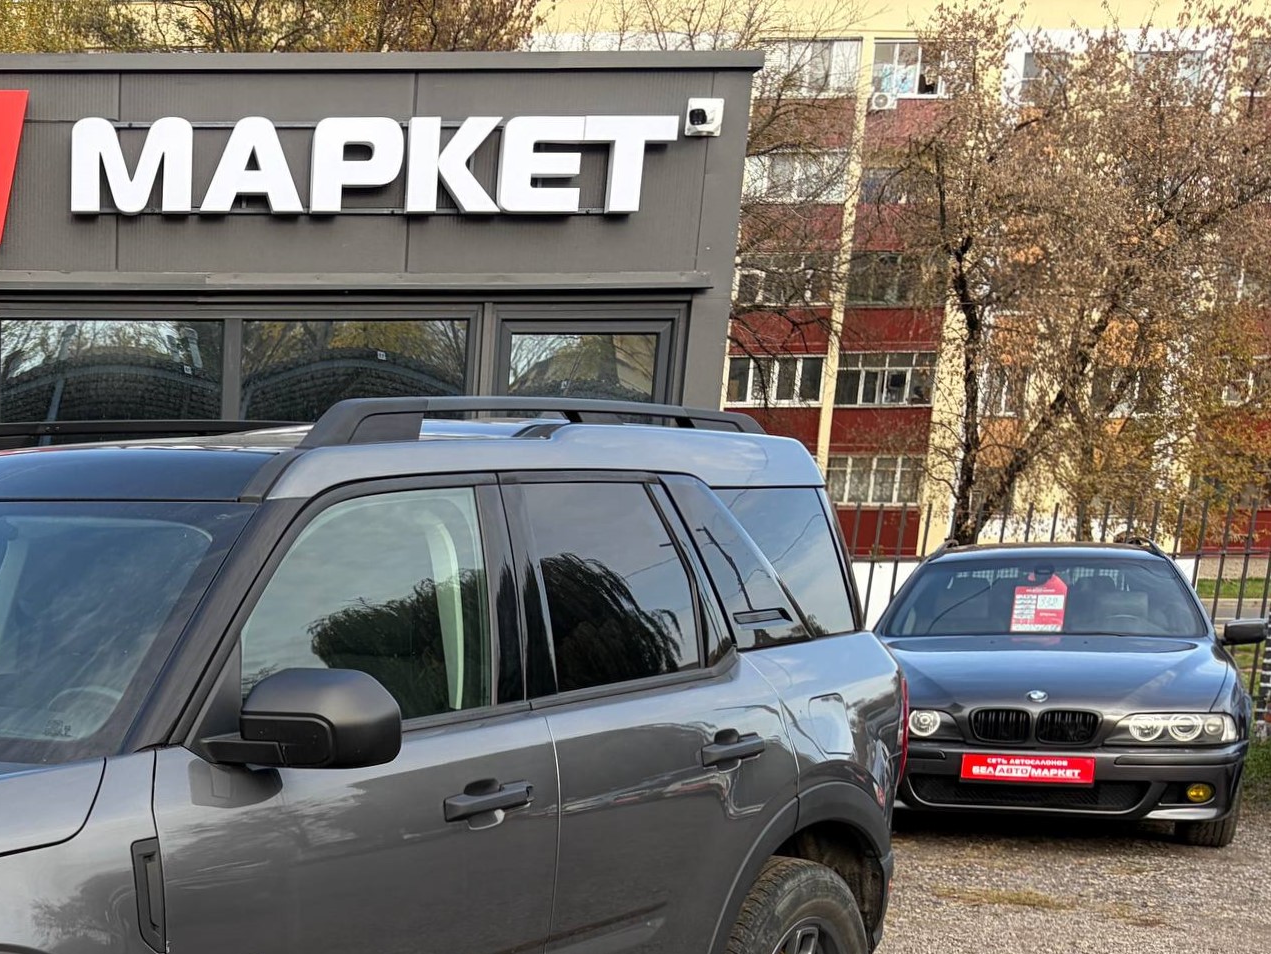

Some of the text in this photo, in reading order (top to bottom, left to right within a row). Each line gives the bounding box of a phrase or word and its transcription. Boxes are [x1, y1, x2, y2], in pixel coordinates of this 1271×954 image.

[71, 115, 680, 215] МАРКЕТ
[987, 757, 1068, 767] СЕТЬ АВТОСАЛОНОВ
[972, 765, 1081, 778] БЕЛ АВТО МАРКЕТ
